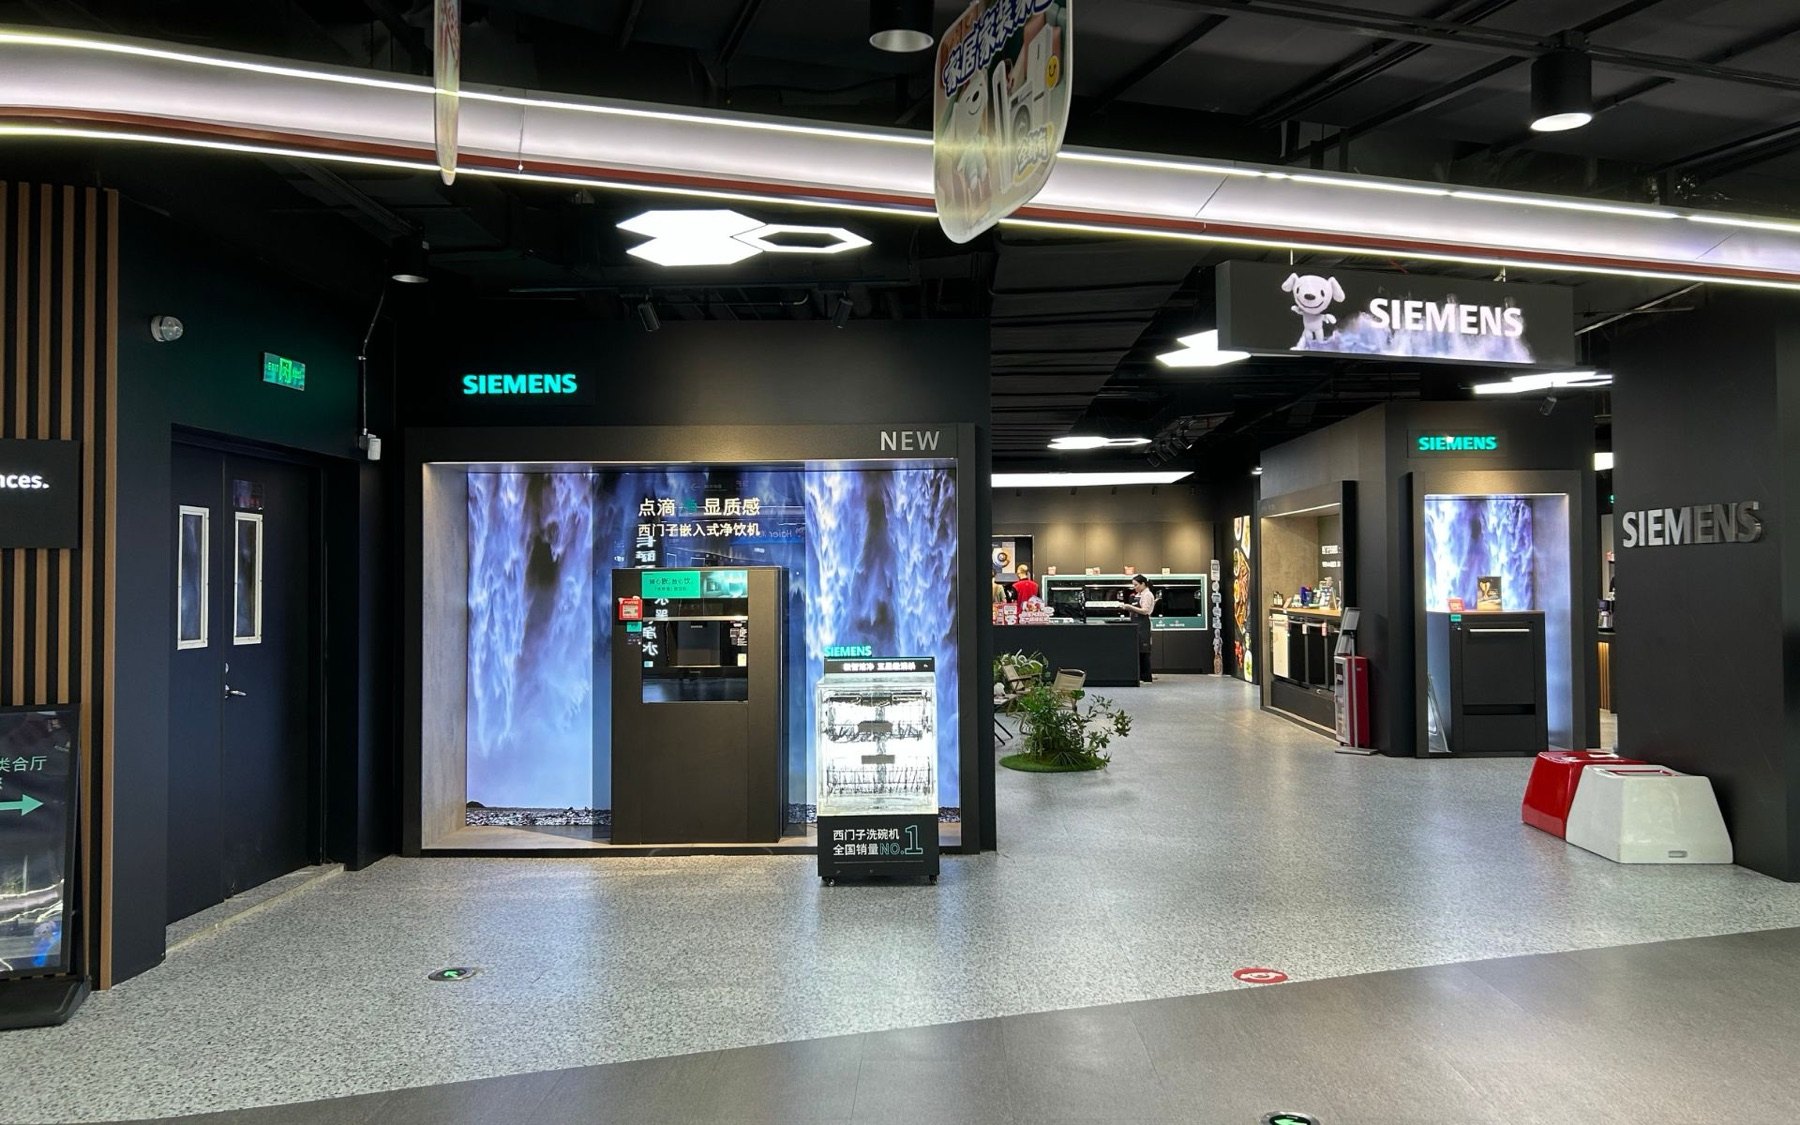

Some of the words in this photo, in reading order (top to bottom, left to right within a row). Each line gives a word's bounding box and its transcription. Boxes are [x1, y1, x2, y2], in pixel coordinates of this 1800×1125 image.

[1369, 297, 1524, 338] SIEMENS
[463, 373, 578, 395] SIEMENS
[880, 430, 940, 451] NEW
[1418, 435, 1498, 451] SIEMENS
[638, 497, 761, 517] 点滴显质感
[1622, 501, 1762, 548] SIEMENS
[824, 645, 872, 658] SIEMENS
[833, 828, 900, 841] 西门子洗碗机
